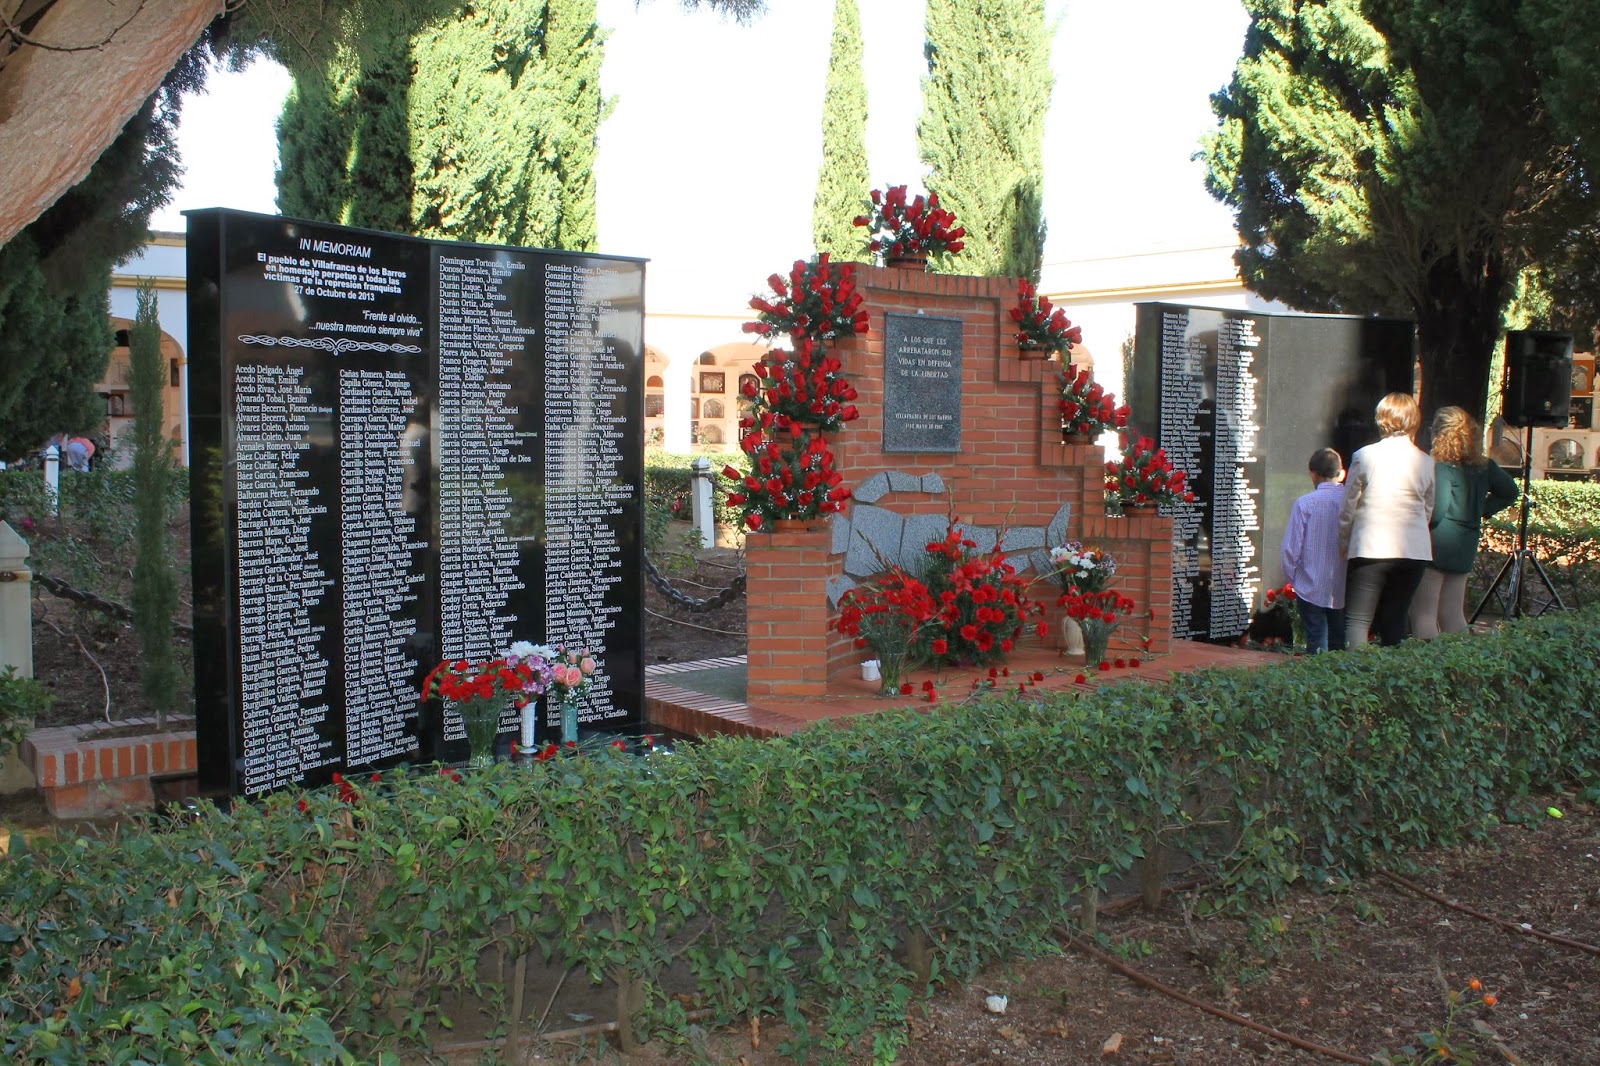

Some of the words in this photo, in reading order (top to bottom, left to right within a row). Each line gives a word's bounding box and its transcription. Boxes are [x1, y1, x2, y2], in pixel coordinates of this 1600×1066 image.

[300, 238, 311, 250] IN
[313, 240, 371, 258] MEMORIAM
[257, 252, 266, 262] El
[269, 255, 297, 265] pueblo
[300, 258, 310, 267] de
[312, 259, 355, 272] Villafranca
[357, 265, 367, 273] de
[369, 266, 380, 275] los
[382, 268, 406, 278] Barros
[440, 264, 463, 272] Donoso
[465, 266, 490, 275] Morales,
[279, 264, 319, 278] homenaje
[322, 271, 357, 280] perpetuo
[366, 275, 387, 284] todas
[389, 277, 400, 285] las
[302, 276, 313, 284] de
[315, 277, 322, 285] la
[364, 282, 401, 294] franquista
[294, 286, 303, 294] 27
[306, 287, 314, 295] de
[317, 288, 346, 298] Octubre
[348, 290, 356, 299] de
[358, 292, 374, 301] 2013
[461, 291, 485, 300] Murillo,
[389, 313, 396, 322] al
[397, 314, 422, 324] olvido...
[464, 316, 490, 325] Morales,
[346, 323, 376, 334] memoria
[378, 325, 405, 337] siempre
[473, 341, 497, 350] Vicente,
[499, 342, 524, 351] Gregorio
[899, 347, 939, 355] ARREBATARON
[236, 365, 255, 374] Acedo
[257, 365, 285, 376] Delgado,
[361, 370, 384, 379] Romero,
[236, 384, 256, 393] Acedo
[257, 385, 277, 394] Rivas,
[340, 379, 361, 388] Capilla
[385, 380, 410, 389] Domingo
[462, 382, 482, 390] Acedo,
[236, 394, 264, 403] Alvarado
[266, 395, 285, 404] Tobal,
[391, 415, 406, 424] Diego
[262, 423, 283, 432] Coleto,
[267, 442, 292, 451] Romero,
[462, 440, 488, 448] Gragera,
[238, 491, 268, 499] Balbuena
[290, 487, 319, 496] Fernando
[238, 511, 261, 520] Barjola
[263, 509, 290, 518] Cabrera,
[239, 558, 271, 567] Benavides
[273, 554, 303, 564] Labrador,
[240, 576, 266, 587] Bermejo
[284, 573, 301, 582] Cruz,
[343, 583, 371, 591] Cidoncha
[405, 574, 425, 583] Gabriel
[441, 580, 463, 588] Gaspar
[493, 575, 518, 583] Manuela
[595, 576, 621, 584] Francisco
[441, 612, 461, 621] Godoy
[546, 627, 567, 635] Llerena
[569, 624, 592, 635] Verjano,
[594, 621, 615, 629] Manuel
[245, 773, 274, 785] Camacho
[276, 768, 298, 777] Sastre,
[300, 760, 321, 771] Narciso
